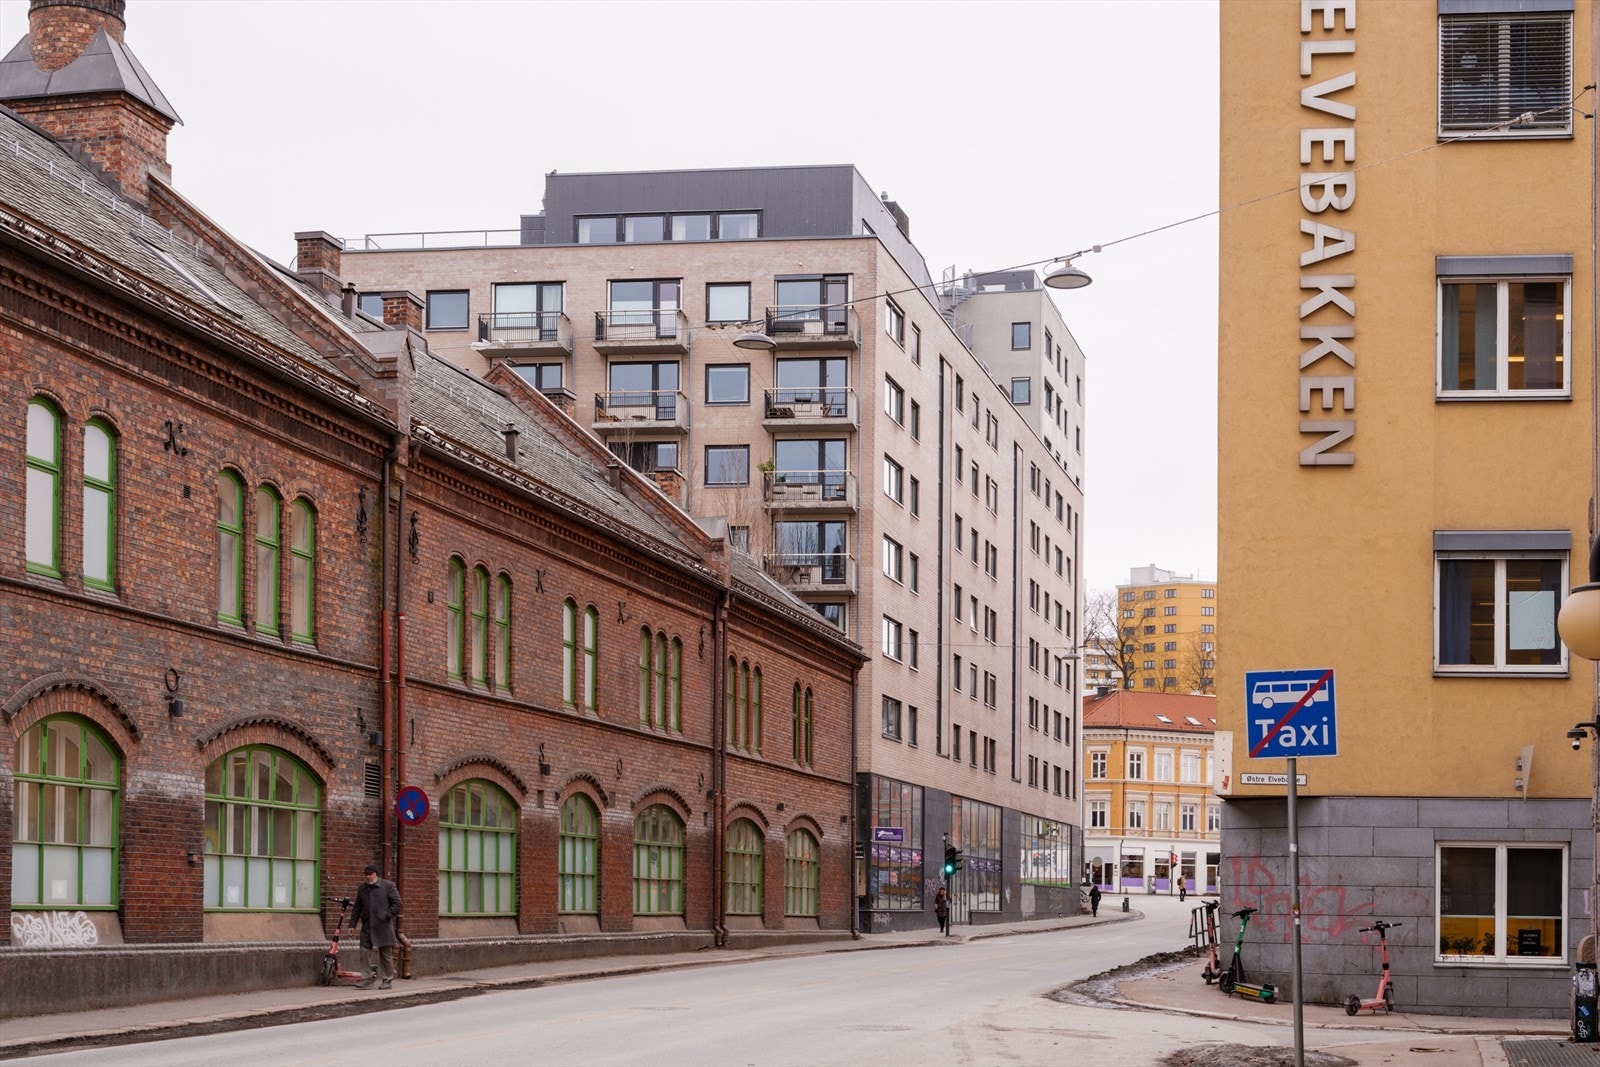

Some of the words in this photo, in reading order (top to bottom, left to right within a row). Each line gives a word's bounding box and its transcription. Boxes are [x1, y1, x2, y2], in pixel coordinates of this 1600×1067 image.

[1299, 0, 1357, 467] ELVEBAKKEN
[1255, 716, 1329, 748] Taxi
[1246, 775, 1265, 783] Østre
[1268, 775, 1301, 784] Elvebae
